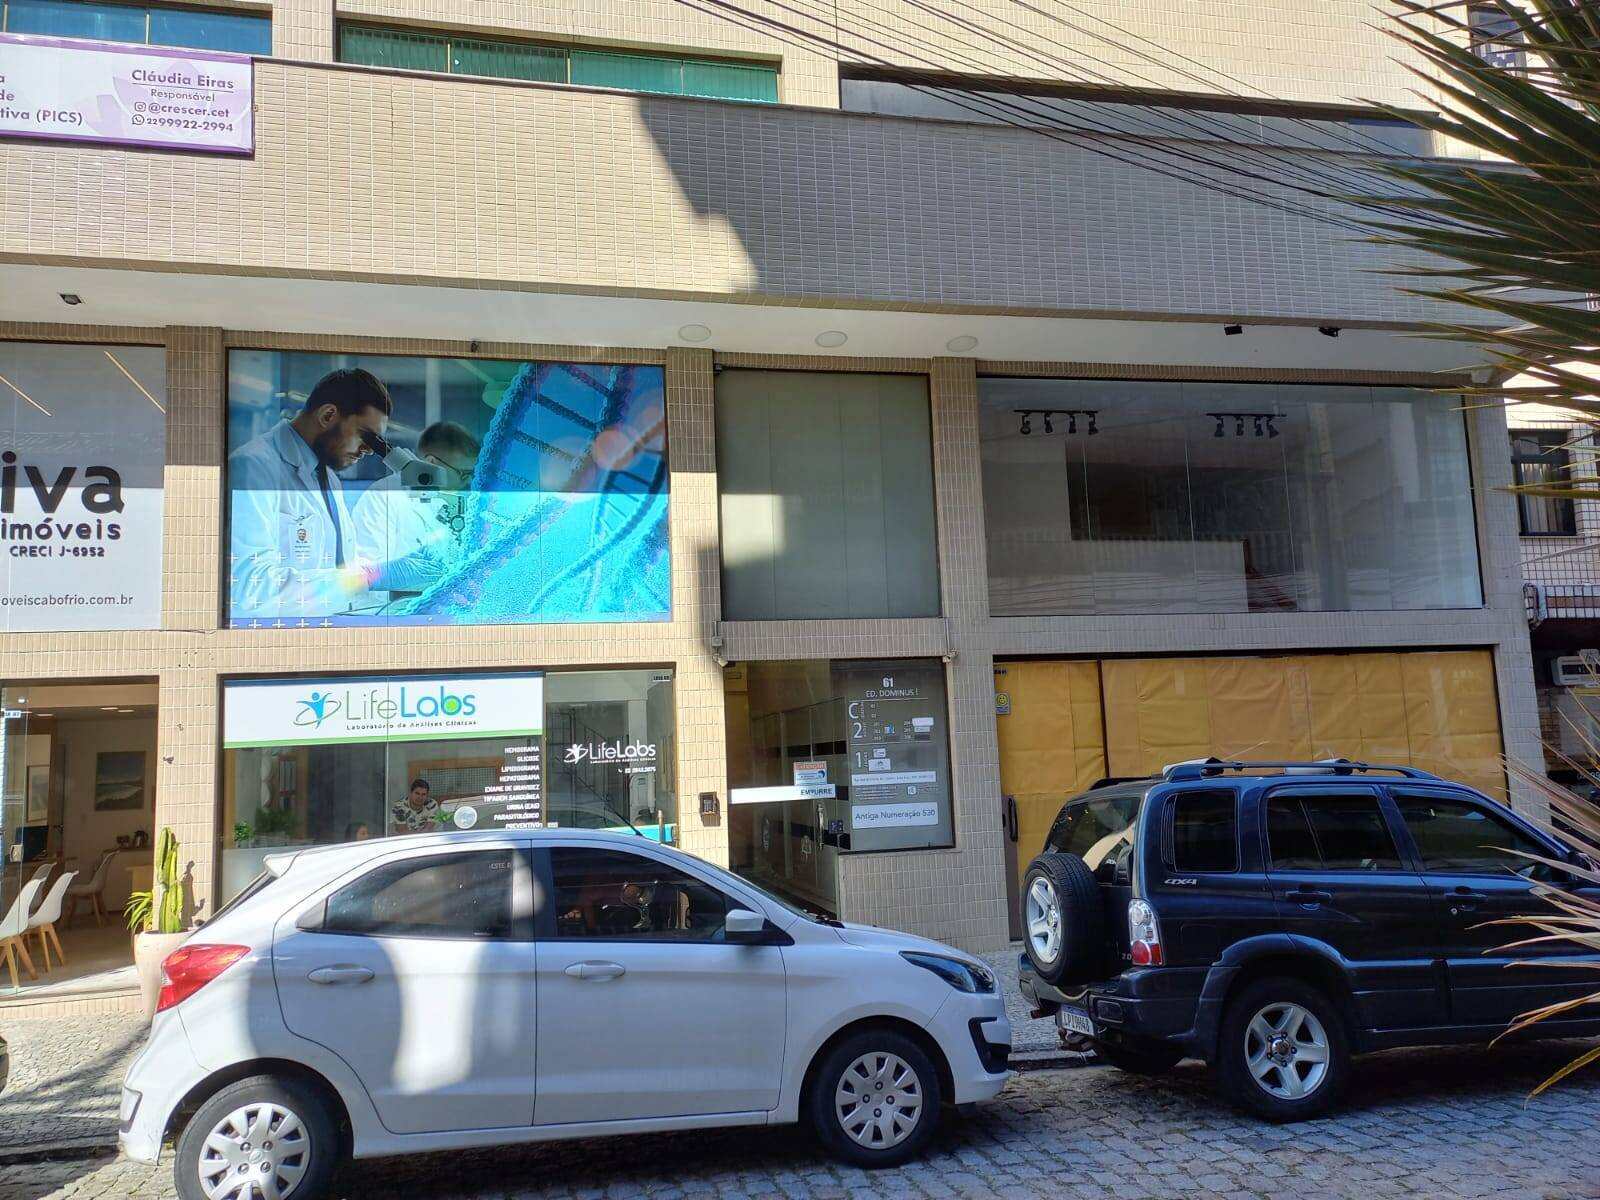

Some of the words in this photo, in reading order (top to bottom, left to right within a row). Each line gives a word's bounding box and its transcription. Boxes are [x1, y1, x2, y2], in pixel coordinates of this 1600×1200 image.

[132, 69, 191, 85] Cláudia
[197, 74, 234, 89] Eiras
[151, 88, 215, 102] Responsável
[36, 109, 83, 126] (PICS)
[1, 450, 125, 514] iva
[1, 517, 122, 540] imóveis
[9, 546, 52, 557] CRECI
[59, 546, 105, 557] J-6952
[882, 677, 894, 688] 61
[879, 688, 914, 697] DOMINUS
[346, 685, 476, 721] LifeLabs
[848, 702, 859, 719] C
[853, 721, 863, 739] 2
[589, 739, 656, 760] LifeLabs
[856, 751, 861, 768] 1
[855, 812, 879, 821] Antiga
[880, 810, 921, 819] Numeração
